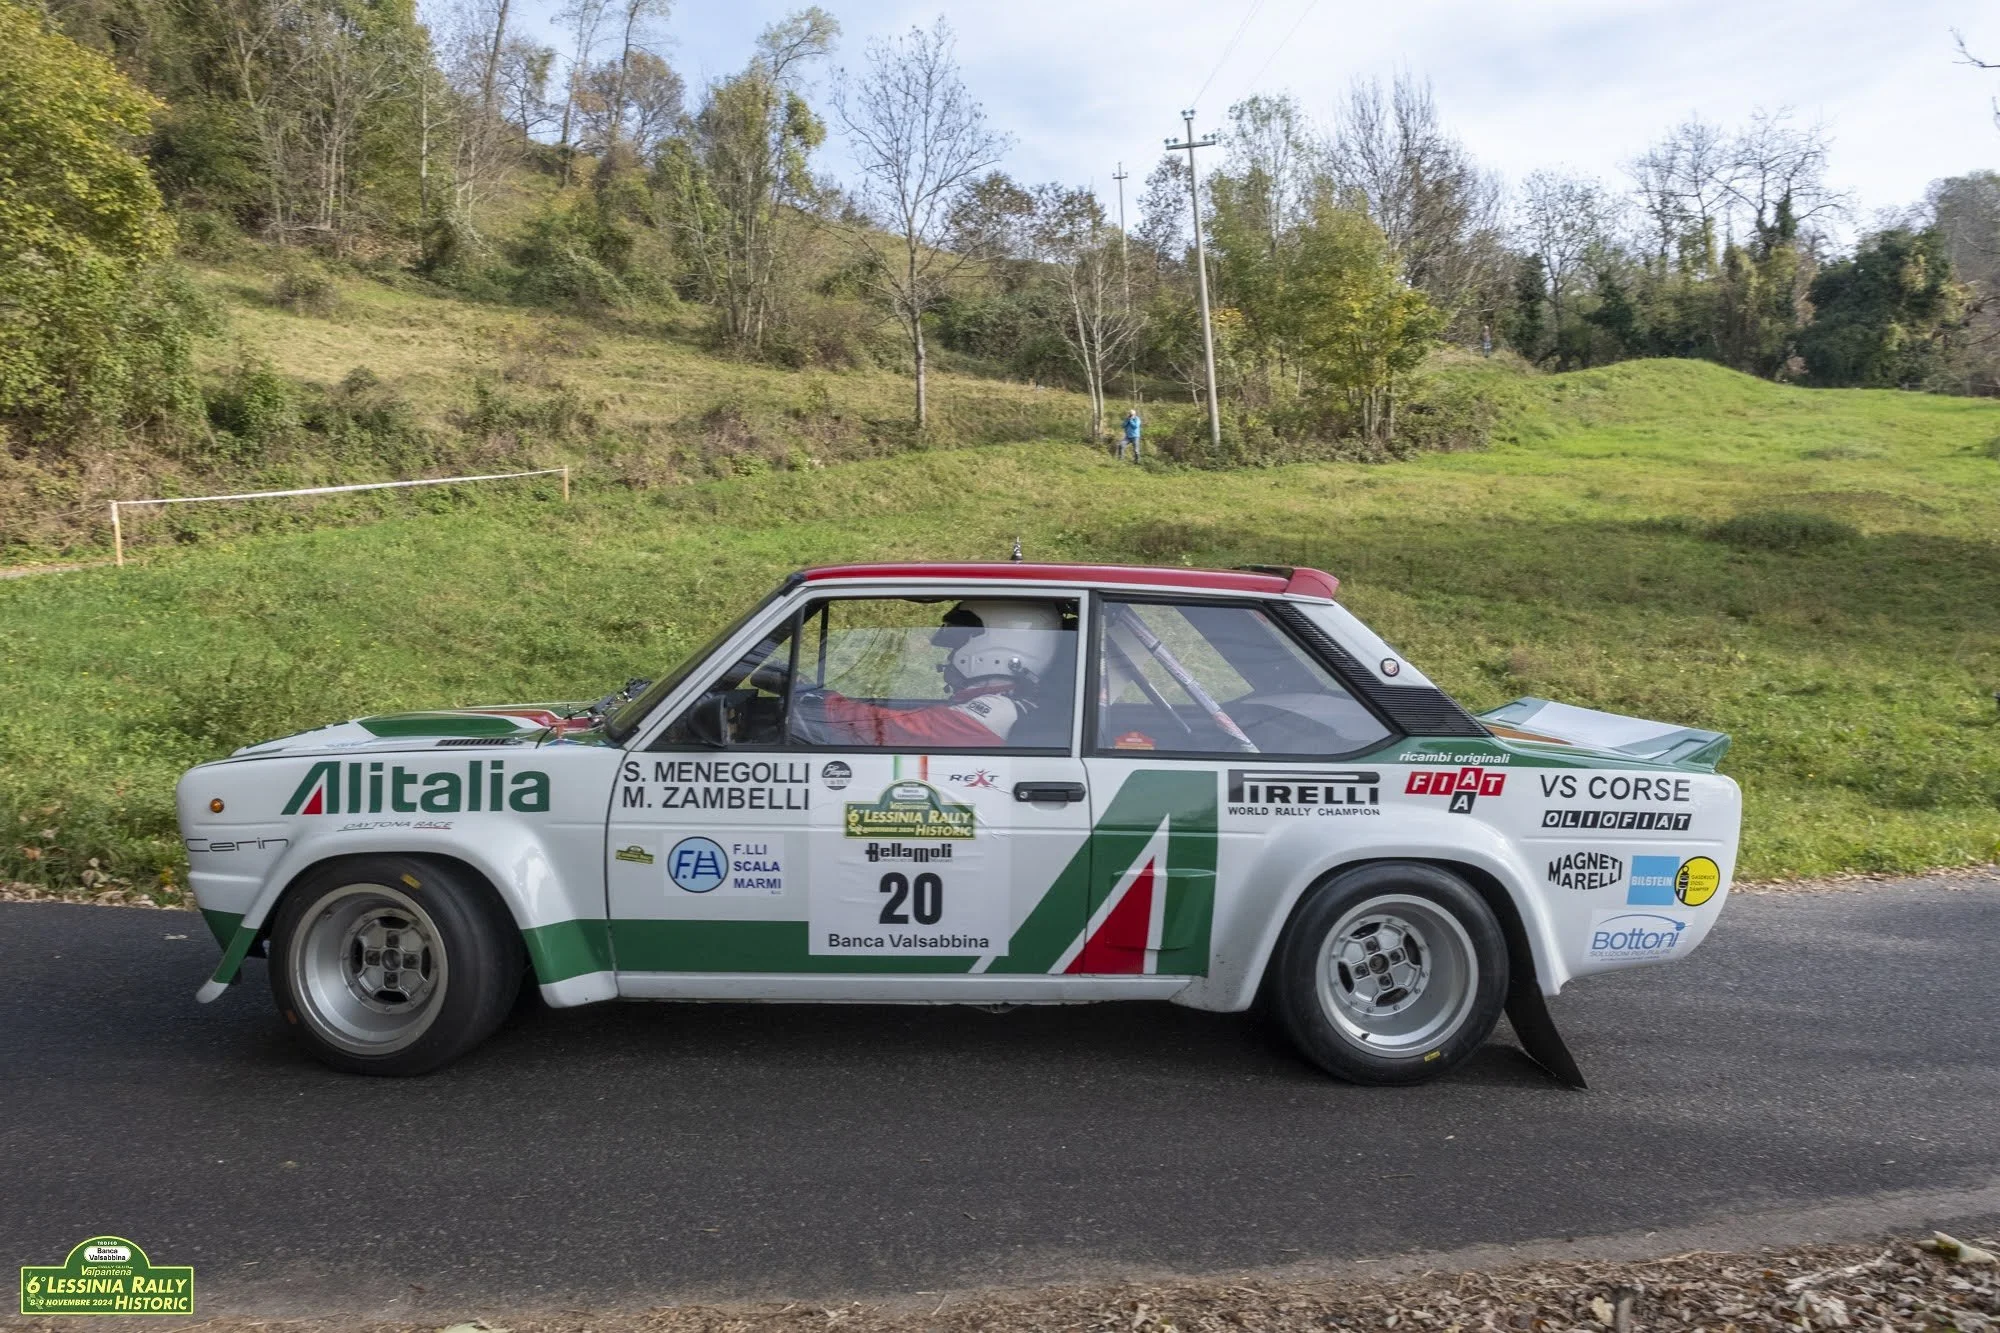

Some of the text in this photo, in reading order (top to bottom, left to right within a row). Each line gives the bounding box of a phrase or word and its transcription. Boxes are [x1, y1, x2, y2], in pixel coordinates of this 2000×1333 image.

[968, 702, 991, 716] OMP
[1400, 752, 1511, 765] ricambi originali
[623, 761, 646, 782] S.
[654, 762, 809, 784] MENEGOLLI
[281, 760, 550, 815] Alitalia
[1228, 769, 1380, 805] PIRELLI
[1407, 768, 1505, 795] FIAT
[1540, 774, 1691, 802] VS CORSE
[623, 786, 809, 810] M. ZAMBELLI
[864, 810, 923, 823] LESSINIA
[928, 810, 971, 823] RALLY
[1228, 807, 1380, 816] WORLD RALLY CHAMPION
[344, 821, 410, 829] DAYTONA
[915, 825, 972, 836] HISTORIC
[733, 844, 767, 855] F.LLI
[865, 843, 952, 862] Bellamoli
[733, 861, 780, 872] SCALA
[1548, 852, 1622, 879] MAGNETI
[733, 878, 781, 889] MARMI
[1548, 862, 1622, 890] MARELLI
[1631, 876, 1674, 887] BILSTEIN
[879, 872, 943, 925] 20
[828, 933, 989, 948] Banca Valsabbina
[1592, 928, 1680, 950] Bottoni
